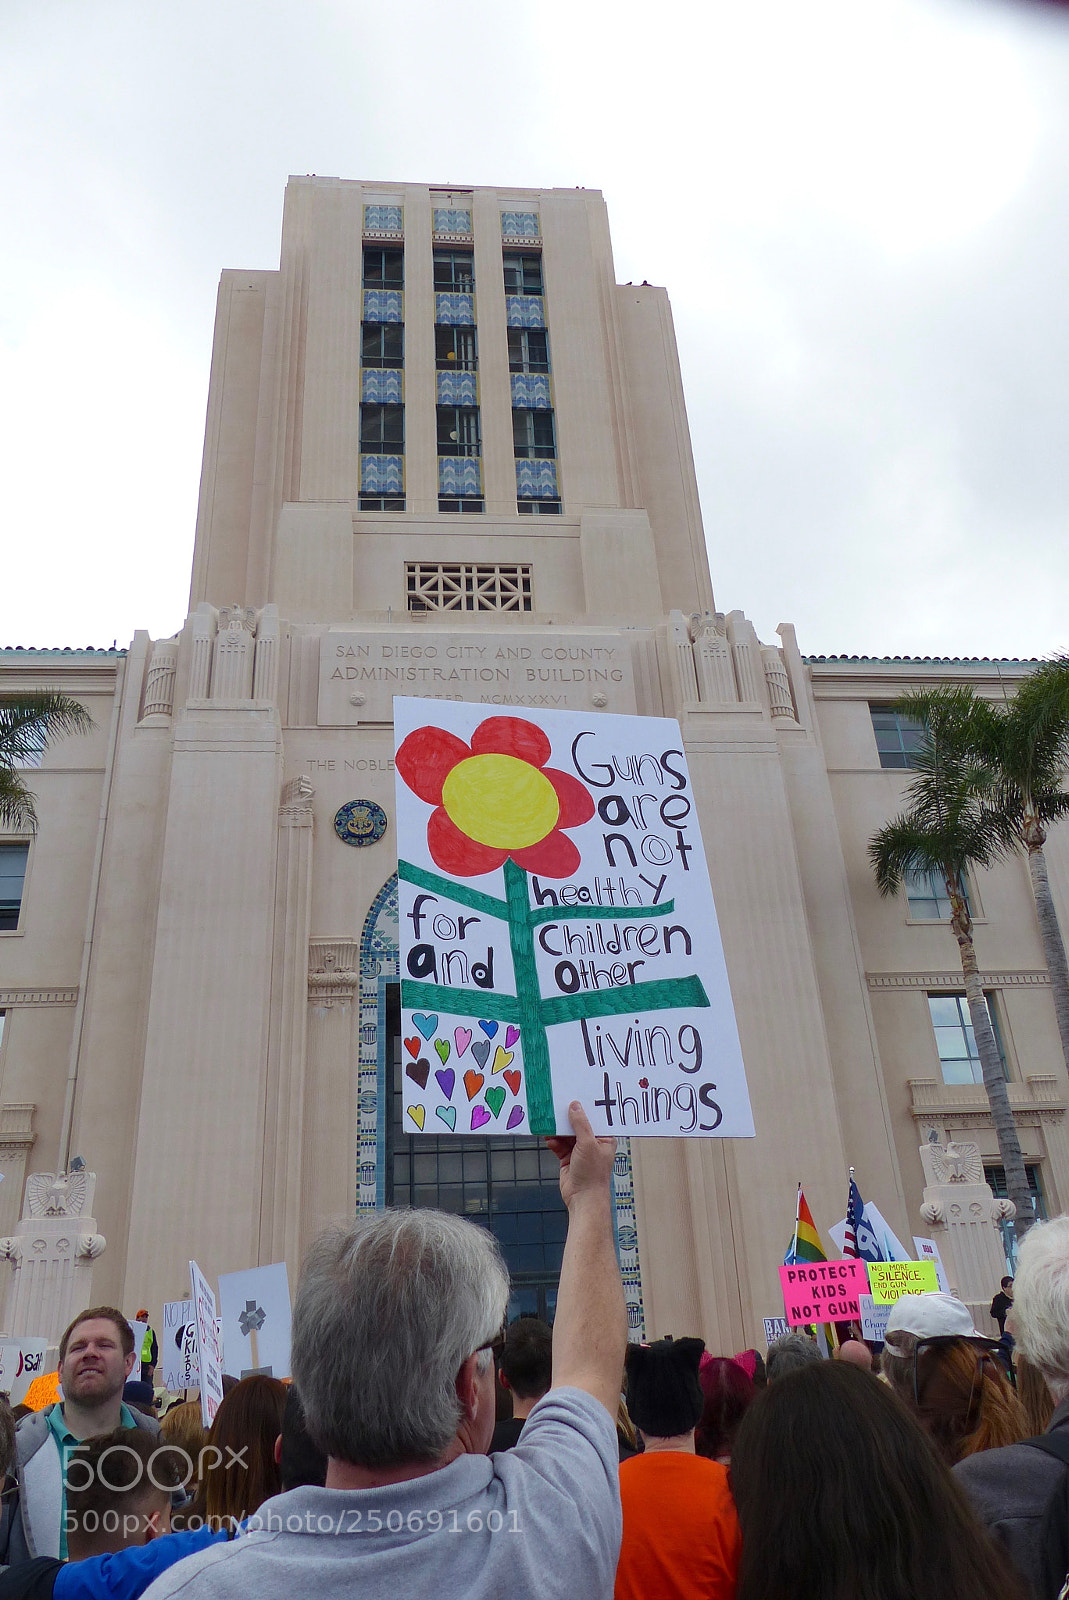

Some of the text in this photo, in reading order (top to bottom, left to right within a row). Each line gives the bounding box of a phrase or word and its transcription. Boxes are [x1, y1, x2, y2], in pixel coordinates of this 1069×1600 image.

[336, 645, 616, 661] SAN DIEGO CITY AND COUNTY
[330, 666, 624, 683] ADMINISTRATION BUILDING
[306, 759, 335, 771] THE
[571, 731, 687, 790] Guns
[597, 793, 691, 831] are
[602, 830, 693, 871] not
[532, 873, 667, 907] healthy
[407, 894, 481, 941] for
[407, 943, 494, 989] and
[580, 1018, 702, 1074] living
[594, 1072, 724, 1133] things
[787, 1265, 857, 1283] PROTECT
[811, 1284, 847, 1299] KIDS
[791, 1301, 859, 1320] NOT GUN
